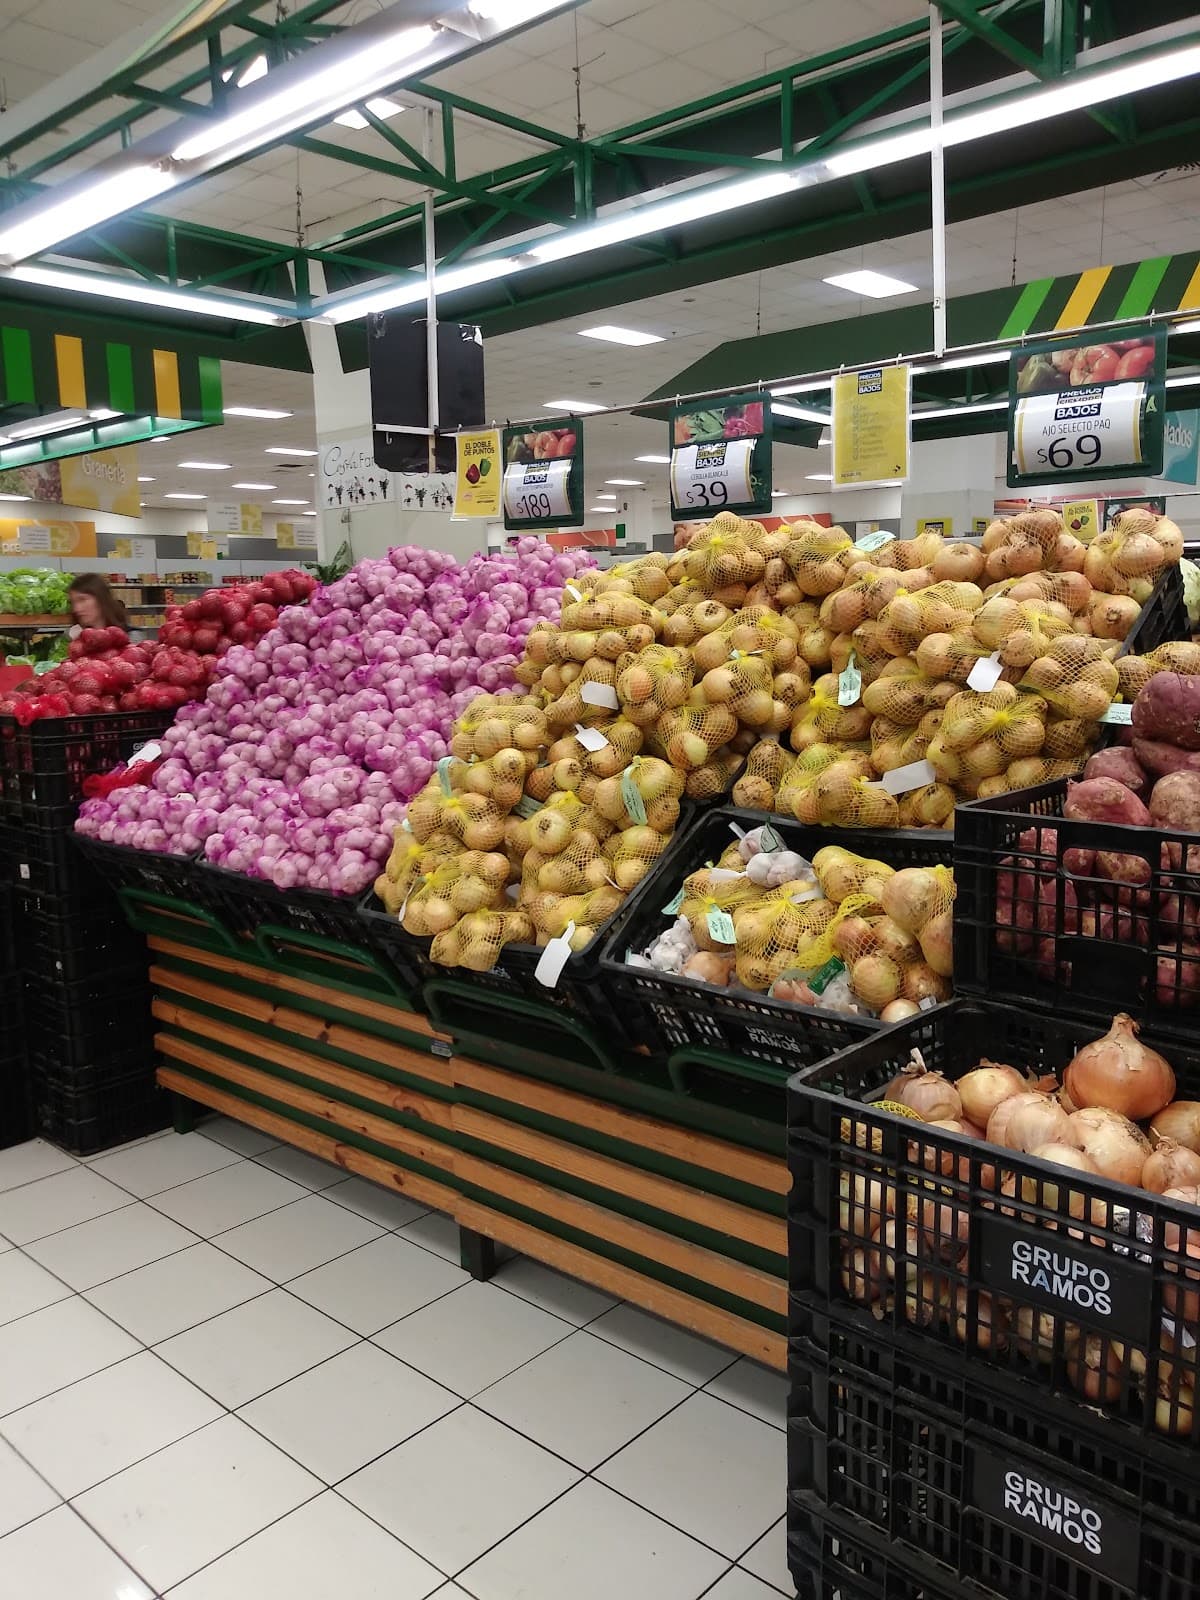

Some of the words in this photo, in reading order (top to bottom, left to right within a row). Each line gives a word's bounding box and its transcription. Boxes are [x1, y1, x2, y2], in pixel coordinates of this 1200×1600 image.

[858, 384, 881, 393] BAJOS
[1056, 404, 1099, 419] BAJOS
[1042, 425, 1057, 436] AJO
[1058, 421, 1092, 434] SELECTO
[1093, 418, 1111, 431] PAQ
[1163, 419, 1193, 449] lados
[465, 442, 472, 450] EL
[473, 440, 492, 449] DOBLE
[472, 447, 495, 455] PUNTOS
[1037, 434, 1102, 469] $69
[696, 456, 724, 468] BAJOS
[524, 473, 547, 484] BAJOS
[686, 481, 728, 506] $39
[516, 493, 551, 518] $189
[748, 1032, 801, 1054] RAMOS
[1012, 1240, 1111, 1292] GRUPO
[1011, 1259, 1112, 1315] RAMOS
[1005, 1471, 1102, 1532] GRUPO
[1004, 1489, 1102, 1555] RAMOS
